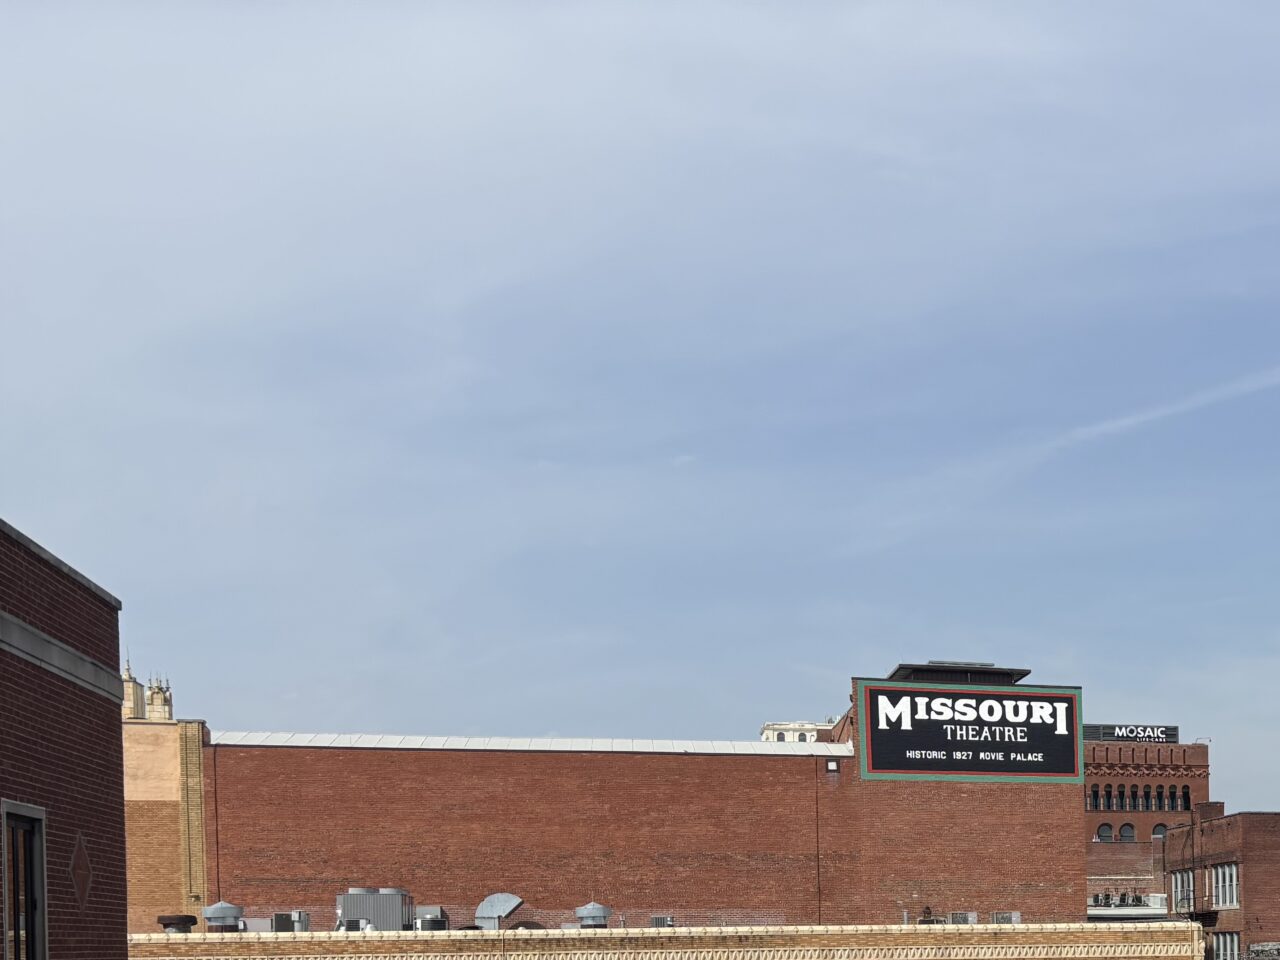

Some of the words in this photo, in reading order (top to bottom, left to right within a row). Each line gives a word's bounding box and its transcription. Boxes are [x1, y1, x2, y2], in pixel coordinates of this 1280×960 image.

[877, 695, 1069, 735] MISSOURI
[943, 725, 1028, 742] THEATRE
[1114, 725, 1166, 738] MOSAIC
[906, 750, 947, 760] HISTORIC
[952, 751, 973, 760] 1927
[979, 752, 1005, 761] MOVIE
[1010, 752, 1044, 762] PALACE
